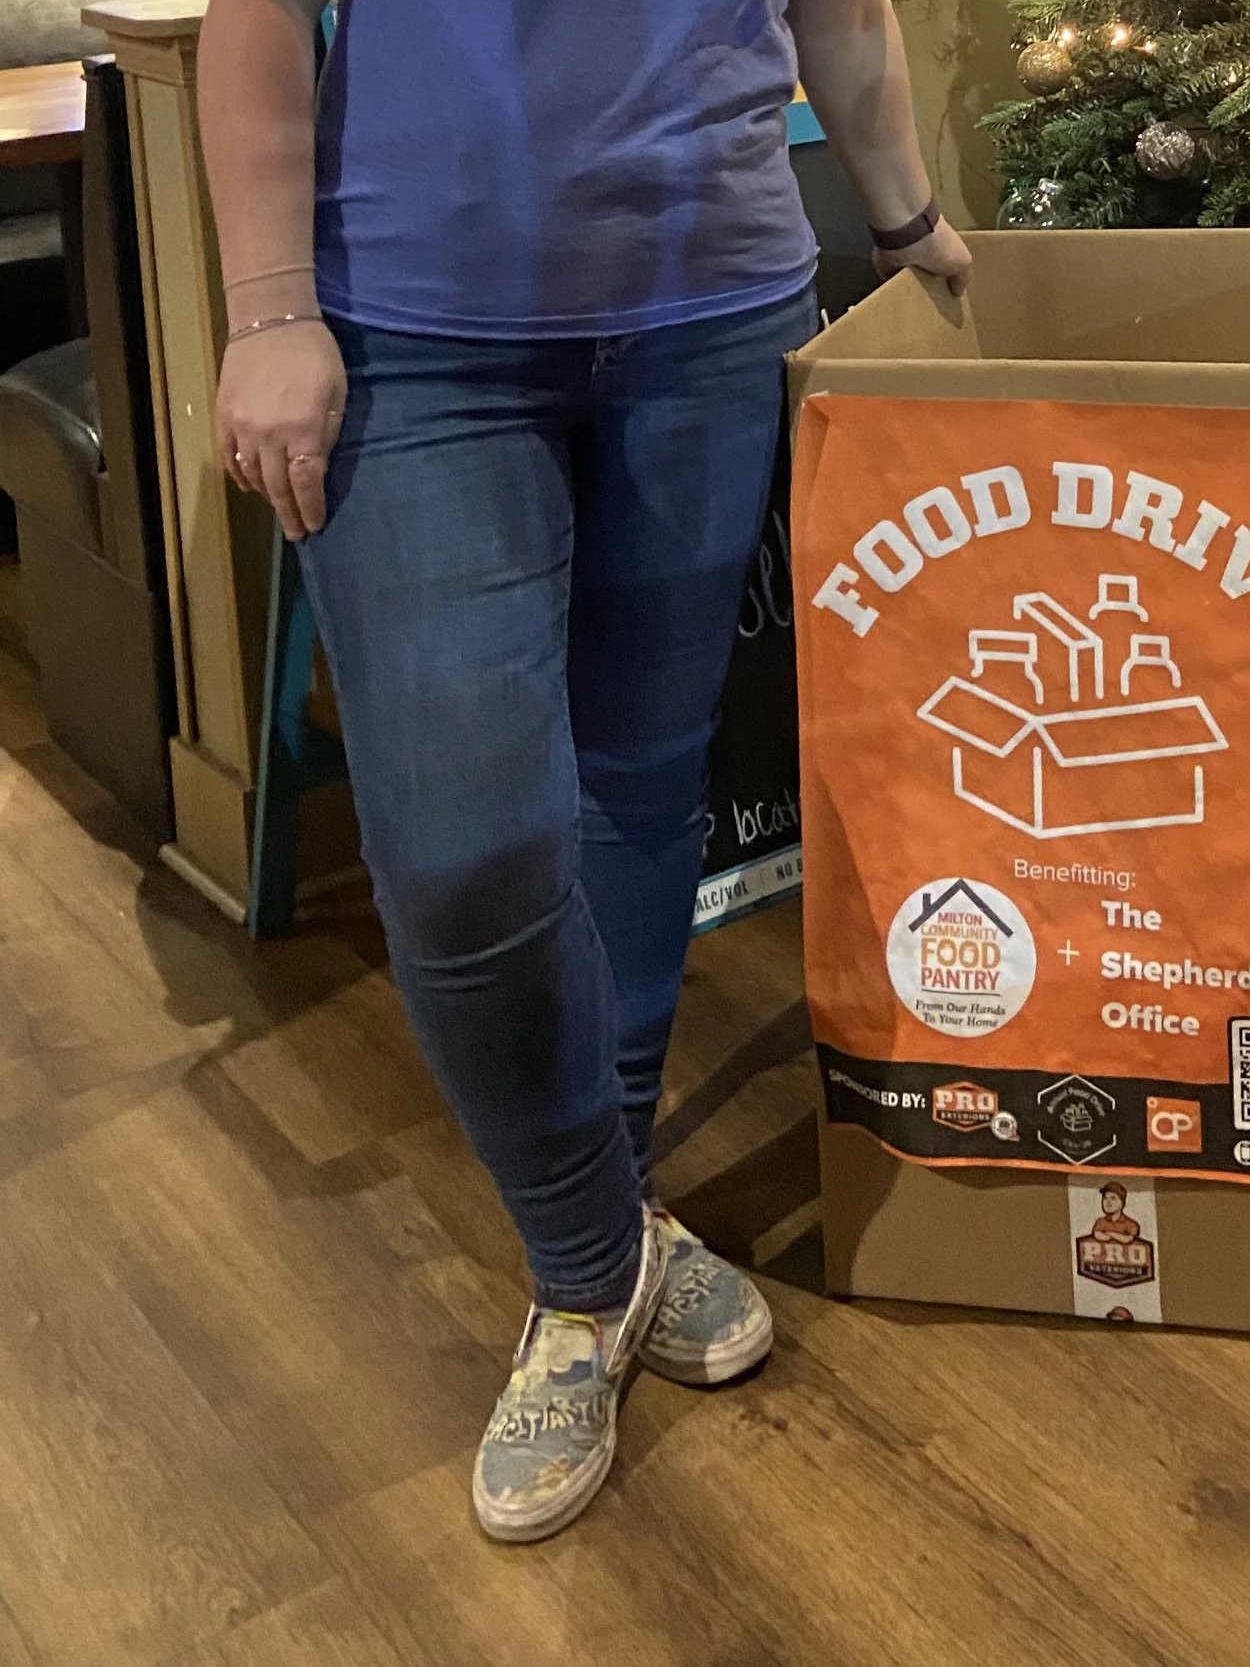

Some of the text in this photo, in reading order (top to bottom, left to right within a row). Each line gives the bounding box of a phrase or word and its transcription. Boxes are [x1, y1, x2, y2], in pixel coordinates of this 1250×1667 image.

[811, 464, 1032, 638] FOOD
[1014, 858, 1137, 890] Benefitting:
[938, 913, 982, 926] MILTON
[1100, 900, 1163, 932] The
[921, 925, 998, 940] COMMUNITY
[921, 938, 1001, 968] FOOD
[921, 967, 1000, 990] PANTRY
[916, 1000, 1006, 1015] From Our Hands
[1100, 1001, 1201, 1036] Office
[923, 1013, 999, 1027] To Your Home
[828, 1069, 926, 1109] SPONSORED BY:
[935, 1090, 995, 1111] PRO
[941, 1112, 990, 1121] EXTERIORS
[1082, 1242, 1146, 1266] PRO
